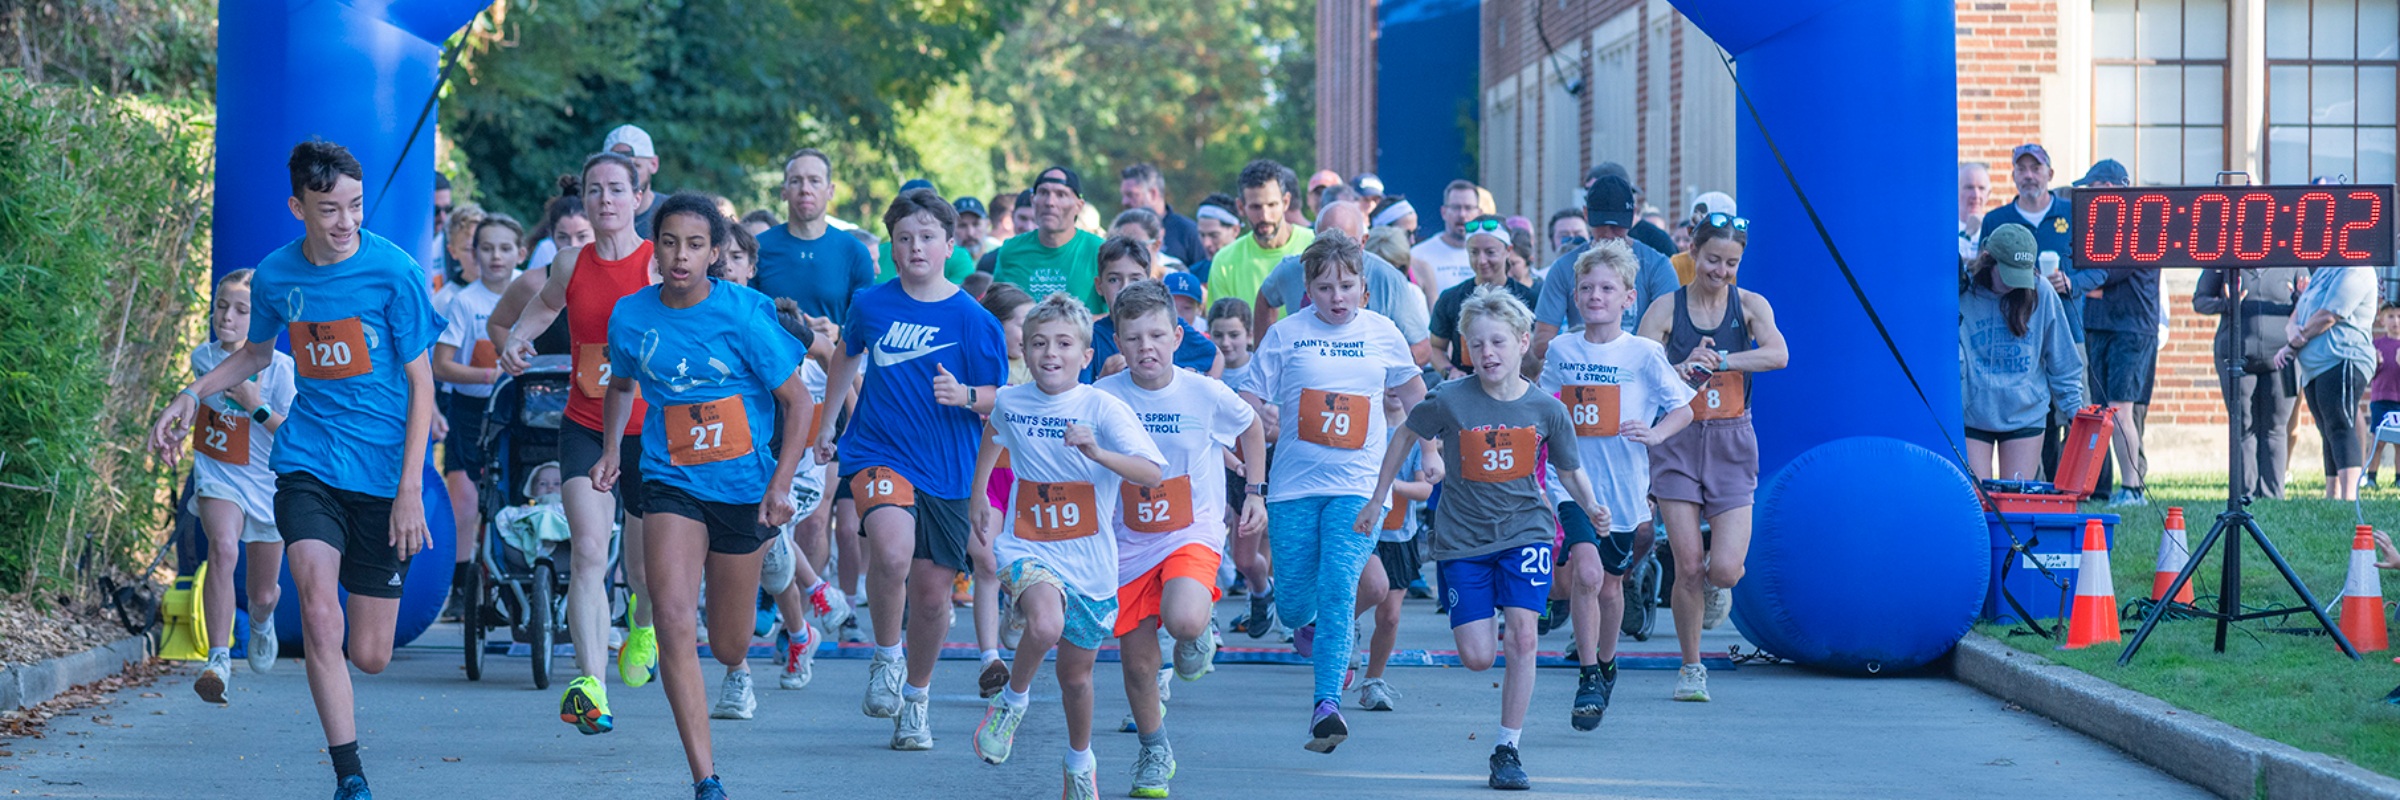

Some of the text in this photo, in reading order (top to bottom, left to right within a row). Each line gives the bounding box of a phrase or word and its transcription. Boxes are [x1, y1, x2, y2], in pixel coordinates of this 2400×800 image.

[2085, 192, 2381, 262] 00:00:02
[882, 321, 941, 351] NIKE
[1293, 339, 1365, 349] SAINTS SPRINT
[305, 341, 352, 367] 120
[1320, 348, 1365, 358] & STROLL
[1559, 363, 1619, 375] SAINTS SPRINT
[1584, 373, 1619, 384] STROLL
[1707, 389, 1721, 409] 8
[1004, 413, 1078, 427] SAINTS SPRINT
[1144, 412, 1181, 422] SPRINT
[1320, 411, 1351, 436] 79
[1573, 403, 1600, 426] 68
[205, 425, 228, 452] 22
[690, 422, 724, 451] 27
[1027, 428, 1065, 439] & STRO
[1482, 448, 1514, 472] 35
[865, 479, 894, 499] 19
[1030, 502, 1081, 529] 119
[1137, 500, 1171, 523] 52
[1521, 546, 1551, 575] 20
